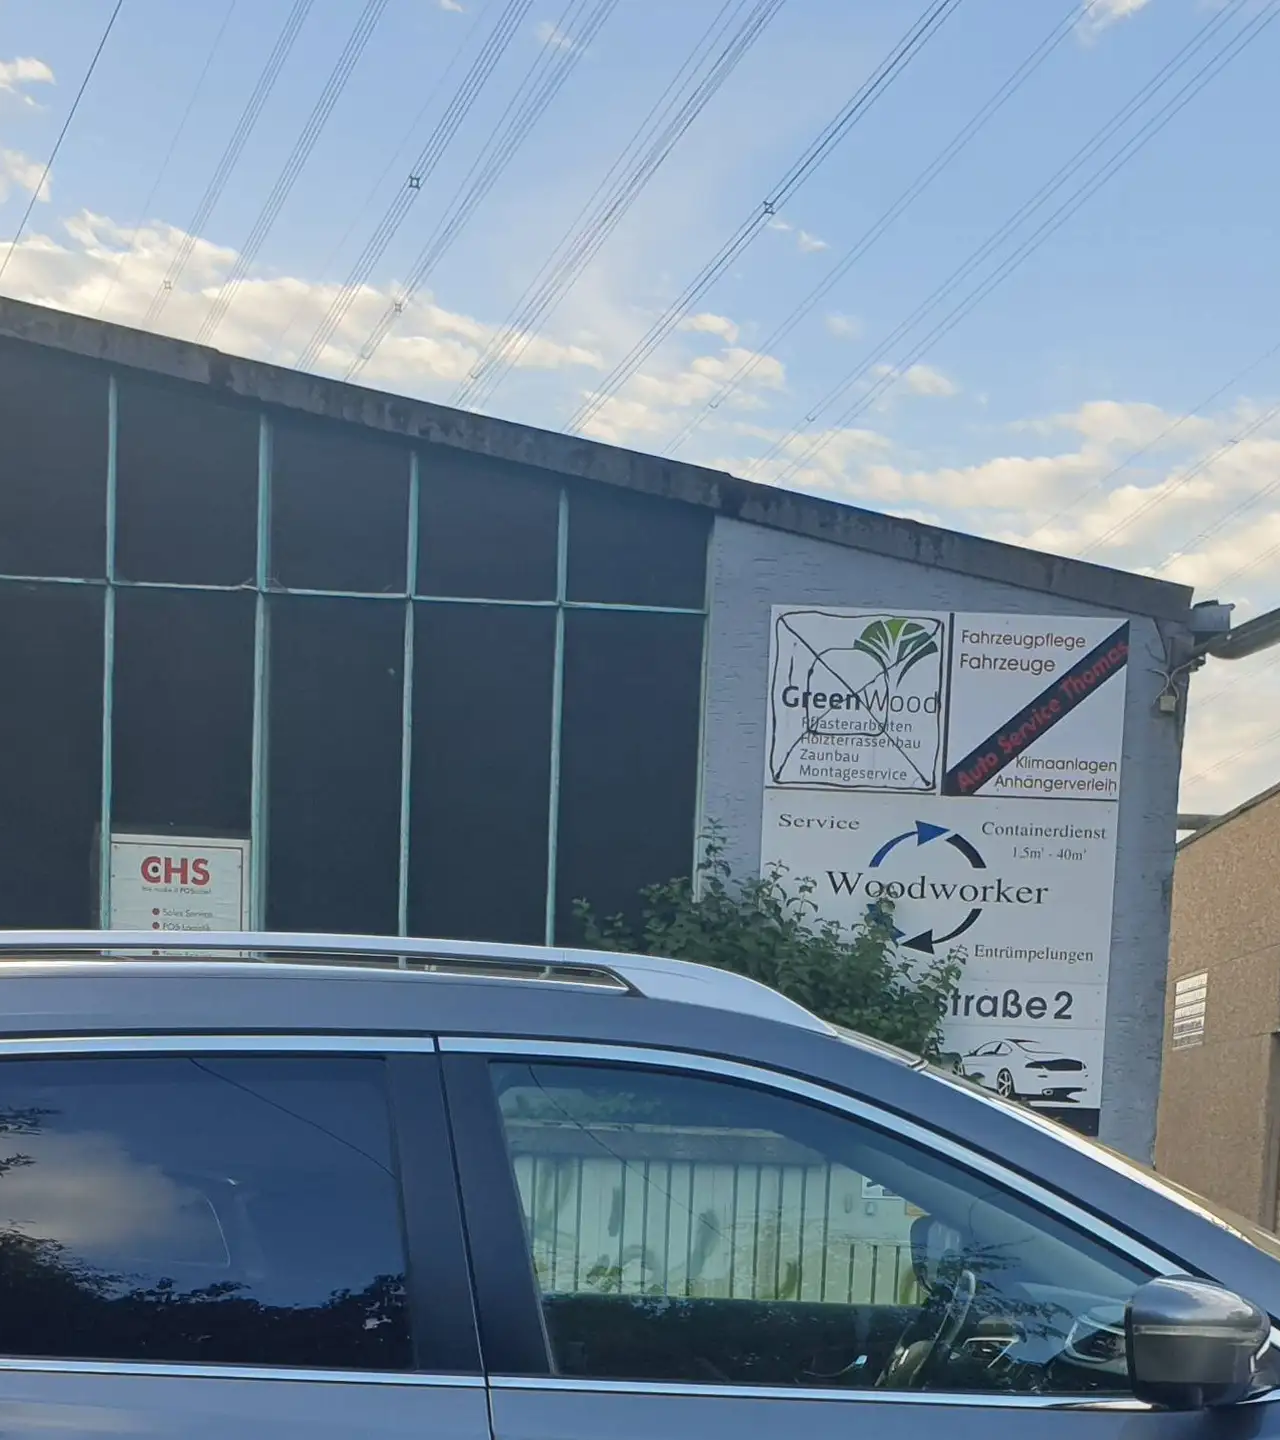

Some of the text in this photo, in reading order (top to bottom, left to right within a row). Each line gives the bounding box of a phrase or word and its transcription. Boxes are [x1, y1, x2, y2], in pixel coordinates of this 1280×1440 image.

[961, 629, 1086, 651] Fahrzeugpflege
[960, 653, 1056, 675] Fahrzeuge
[801, 716, 913, 733] Pflasterarbeiten
[957, 641, 1129, 792] Auto Service Thomas
[800, 733, 921, 749] Holzterrassenbau
[799, 748, 859, 763] Zaunbau
[1015, 756, 1118, 774] Klimaanlagen
[799, 764, 908, 782] Montageservice
[994, 775, 1117, 794] Anhängerverleih
[778, 813, 860, 830] Service
[981, 821, 1107, 839] Containerdienst
[140, 855, 210, 886] CHS
[826, 869, 1049, 905] Woodworker
[974, 943, 1094, 964] Entrümpelungen
[1053, 990, 1074, 1020] 2
